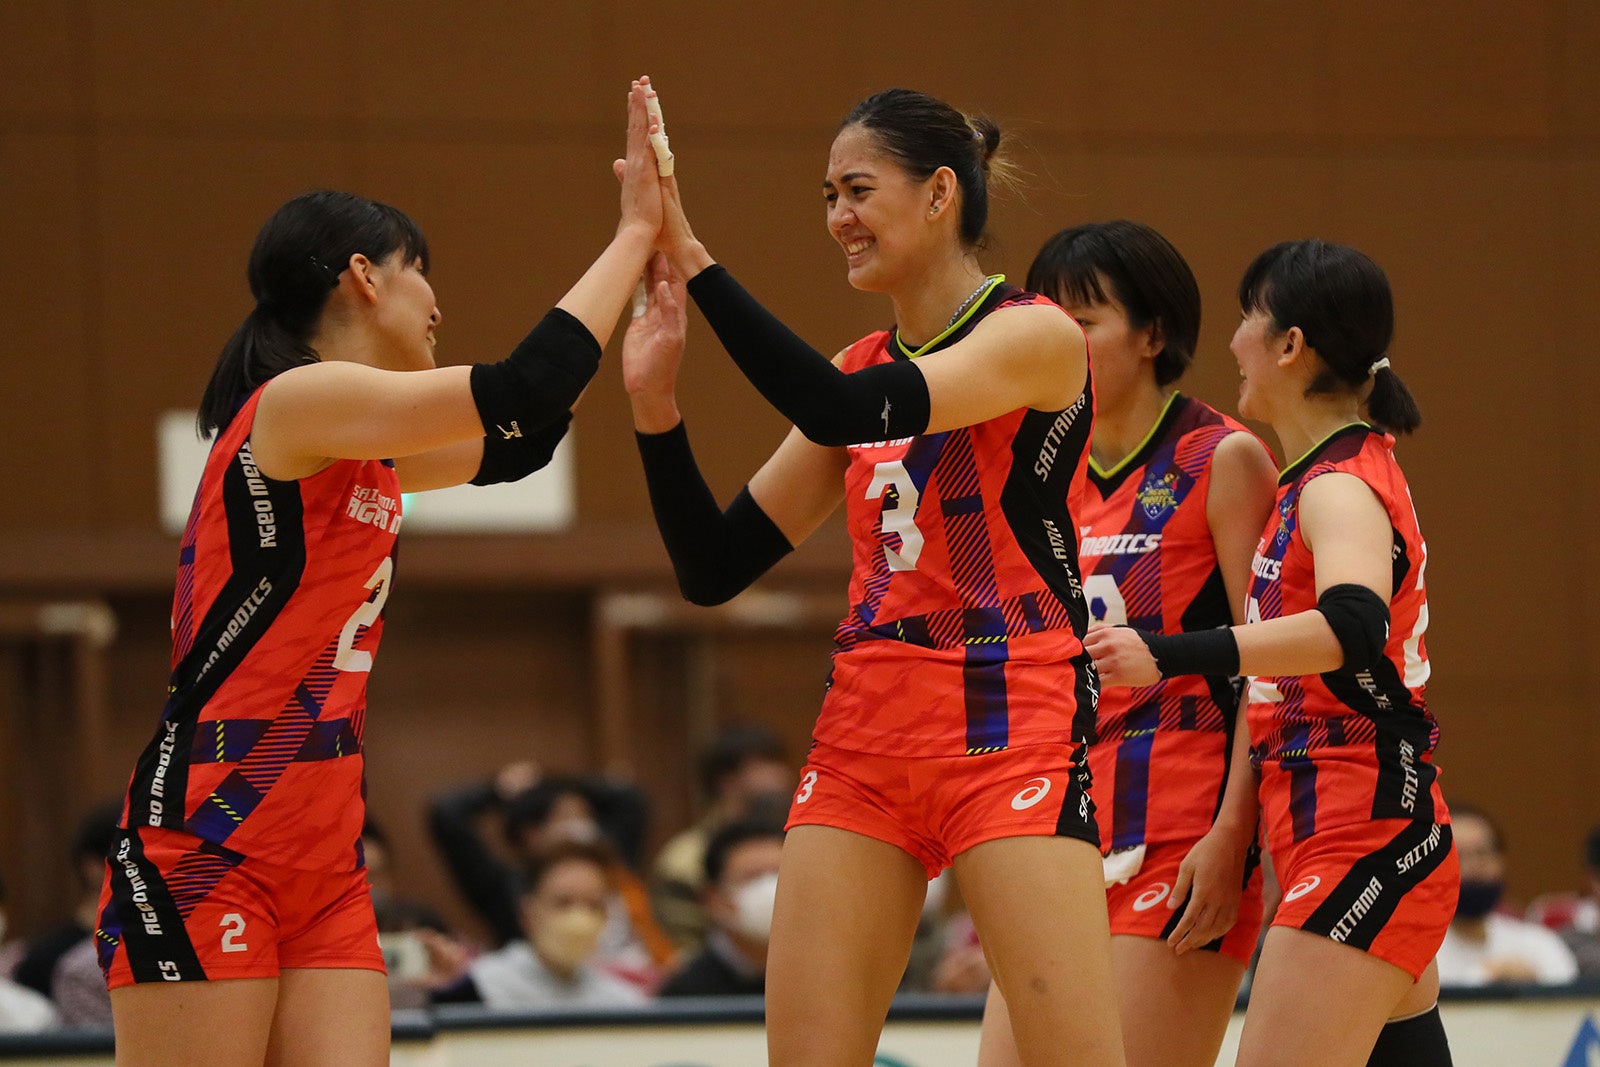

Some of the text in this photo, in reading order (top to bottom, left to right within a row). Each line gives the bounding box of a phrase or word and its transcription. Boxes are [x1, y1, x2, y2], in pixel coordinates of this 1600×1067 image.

[1034, 392, 1086, 482] SAITAMA
[864, 459, 925, 572] 3
[1042, 518, 1082, 599] SAAMA
[332, 556, 393, 673] 2
[797, 771, 818, 804] 3
[1396, 823, 1442, 875] SAITAM
[219, 913, 248, 953] 2
[1329, 875, 1383, 943] AITAMA
